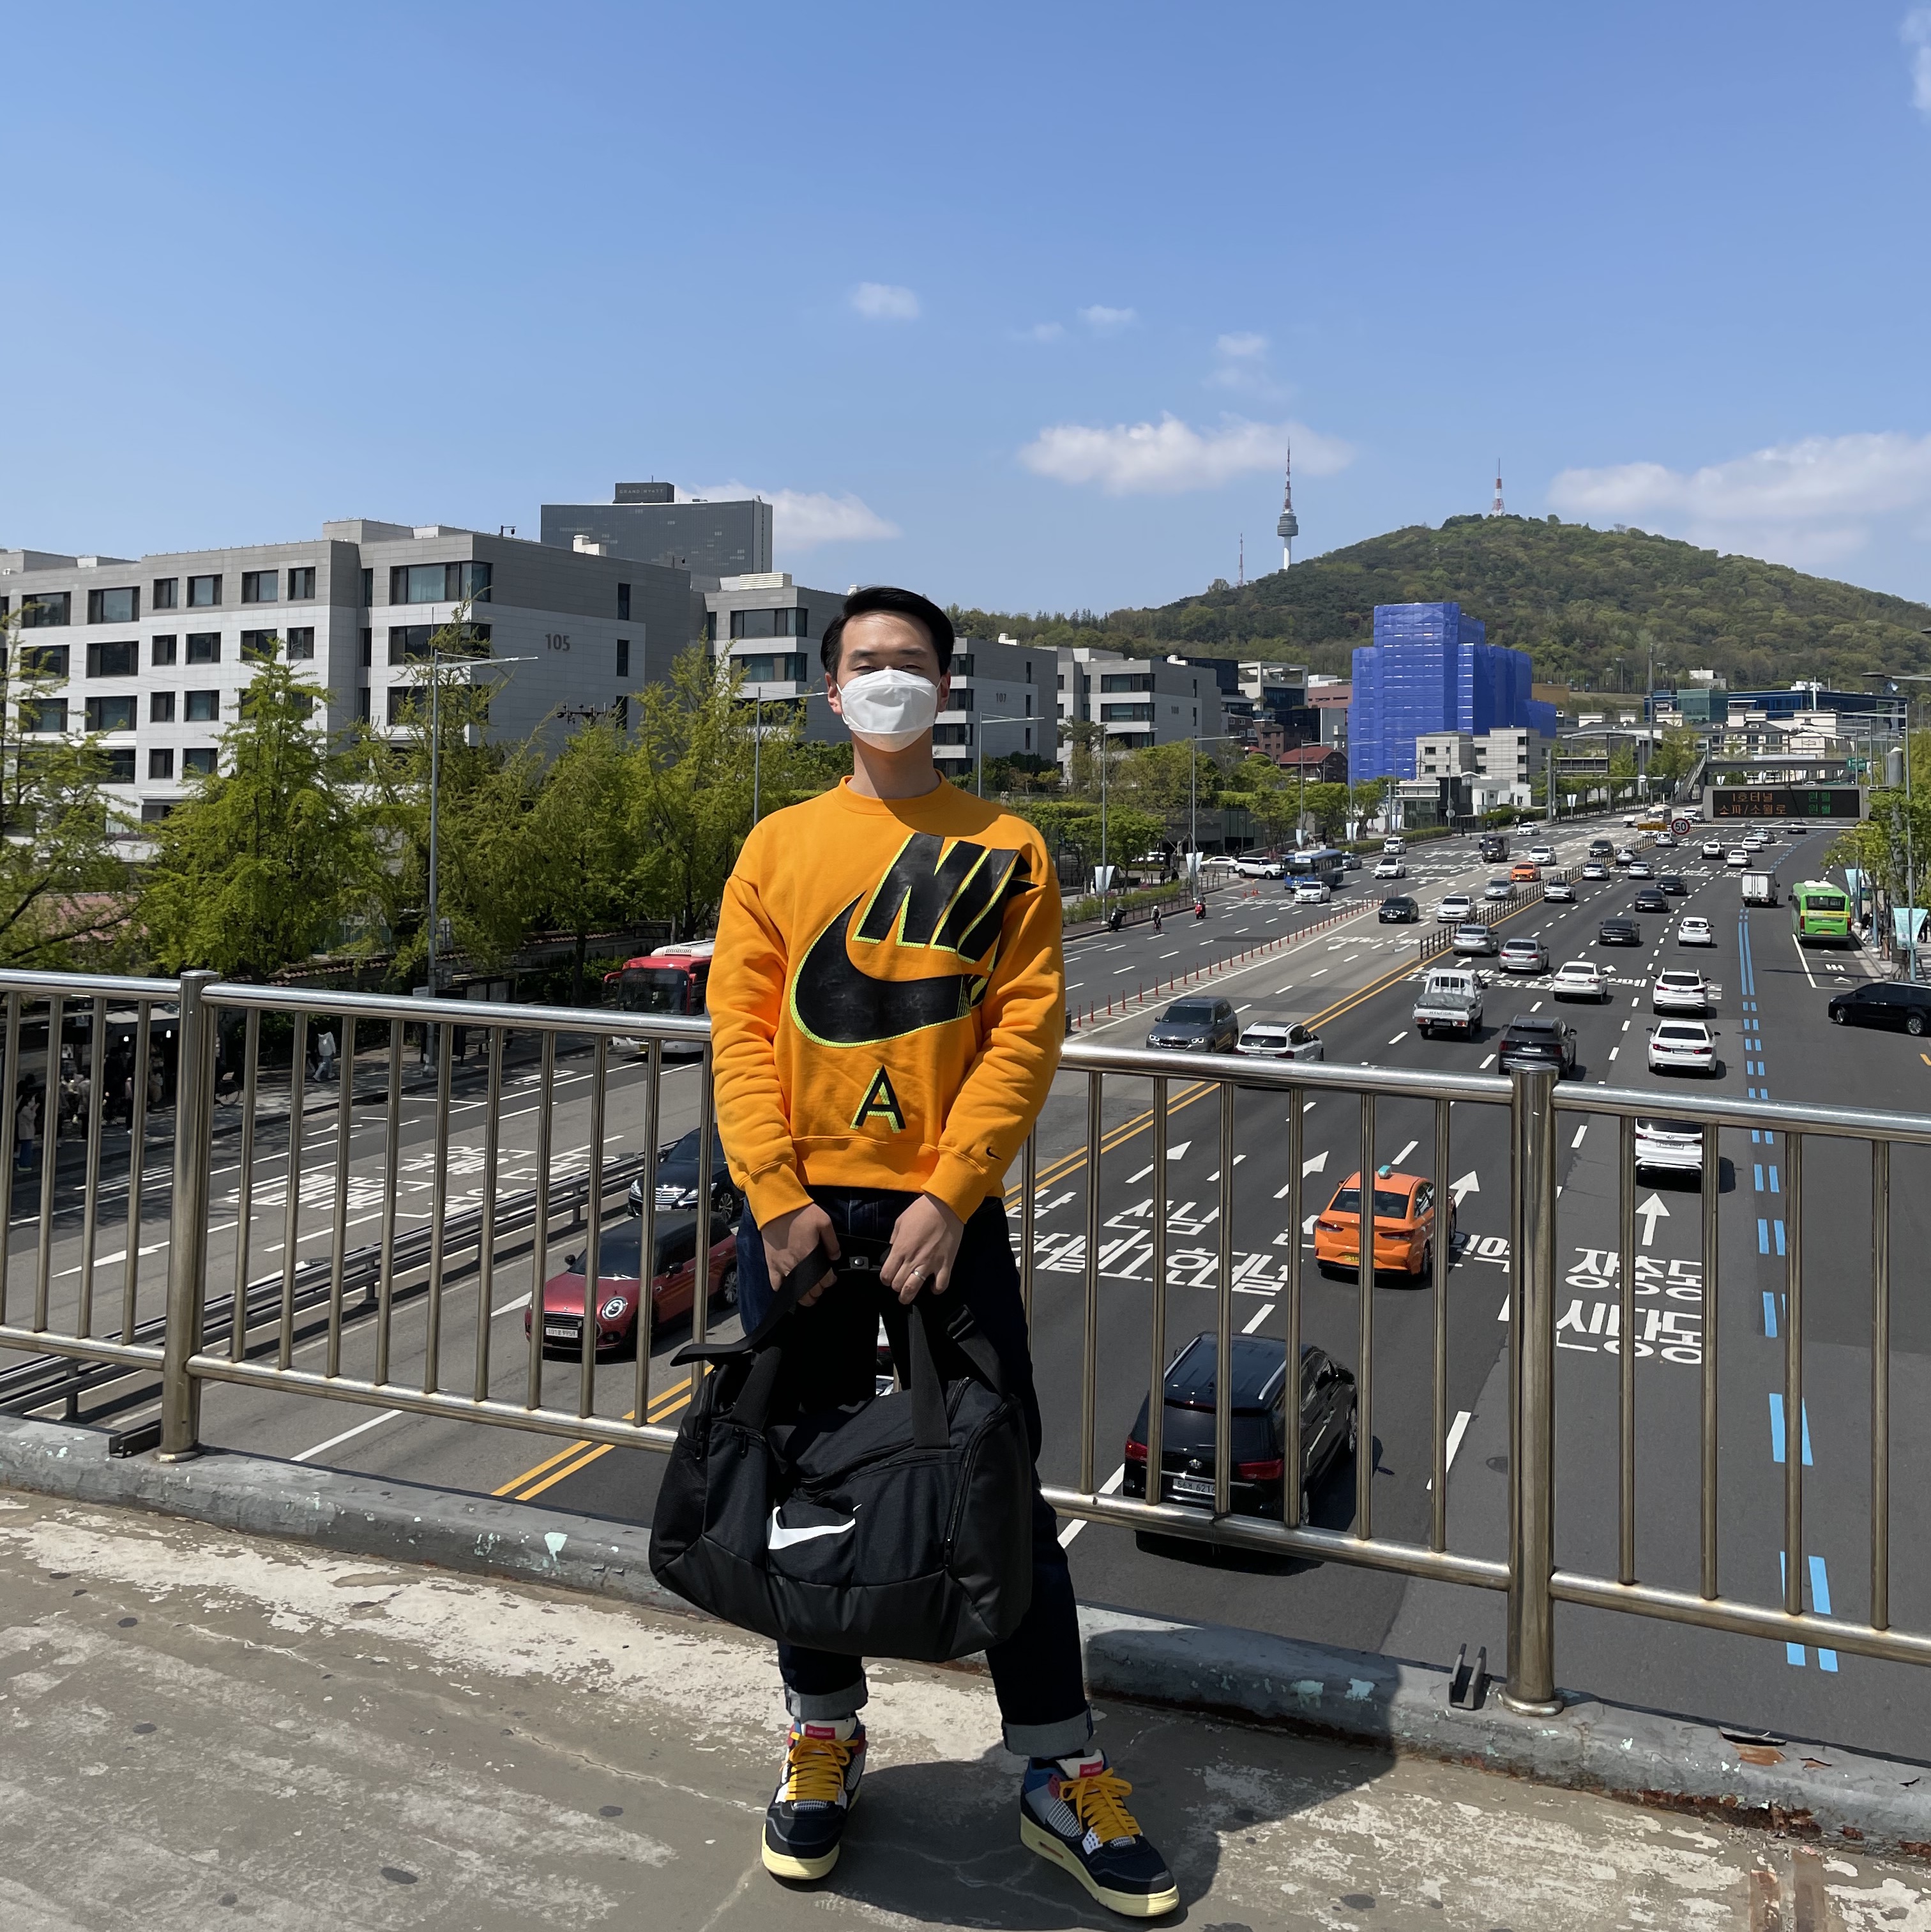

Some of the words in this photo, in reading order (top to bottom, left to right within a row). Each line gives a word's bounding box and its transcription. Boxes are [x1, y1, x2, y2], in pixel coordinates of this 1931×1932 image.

[545, 634, 570, 651] 105
[996, 693, 1006, 703] 107
[1732, 791, 1773, 802] 1호터널
[1676, 822, 1686, 831] 50
[849, 1064, 906, 1134] A
[1564, 1247, 1702, 1301] 장충동
[1556, 1299, 1702, 1364] 신당동
